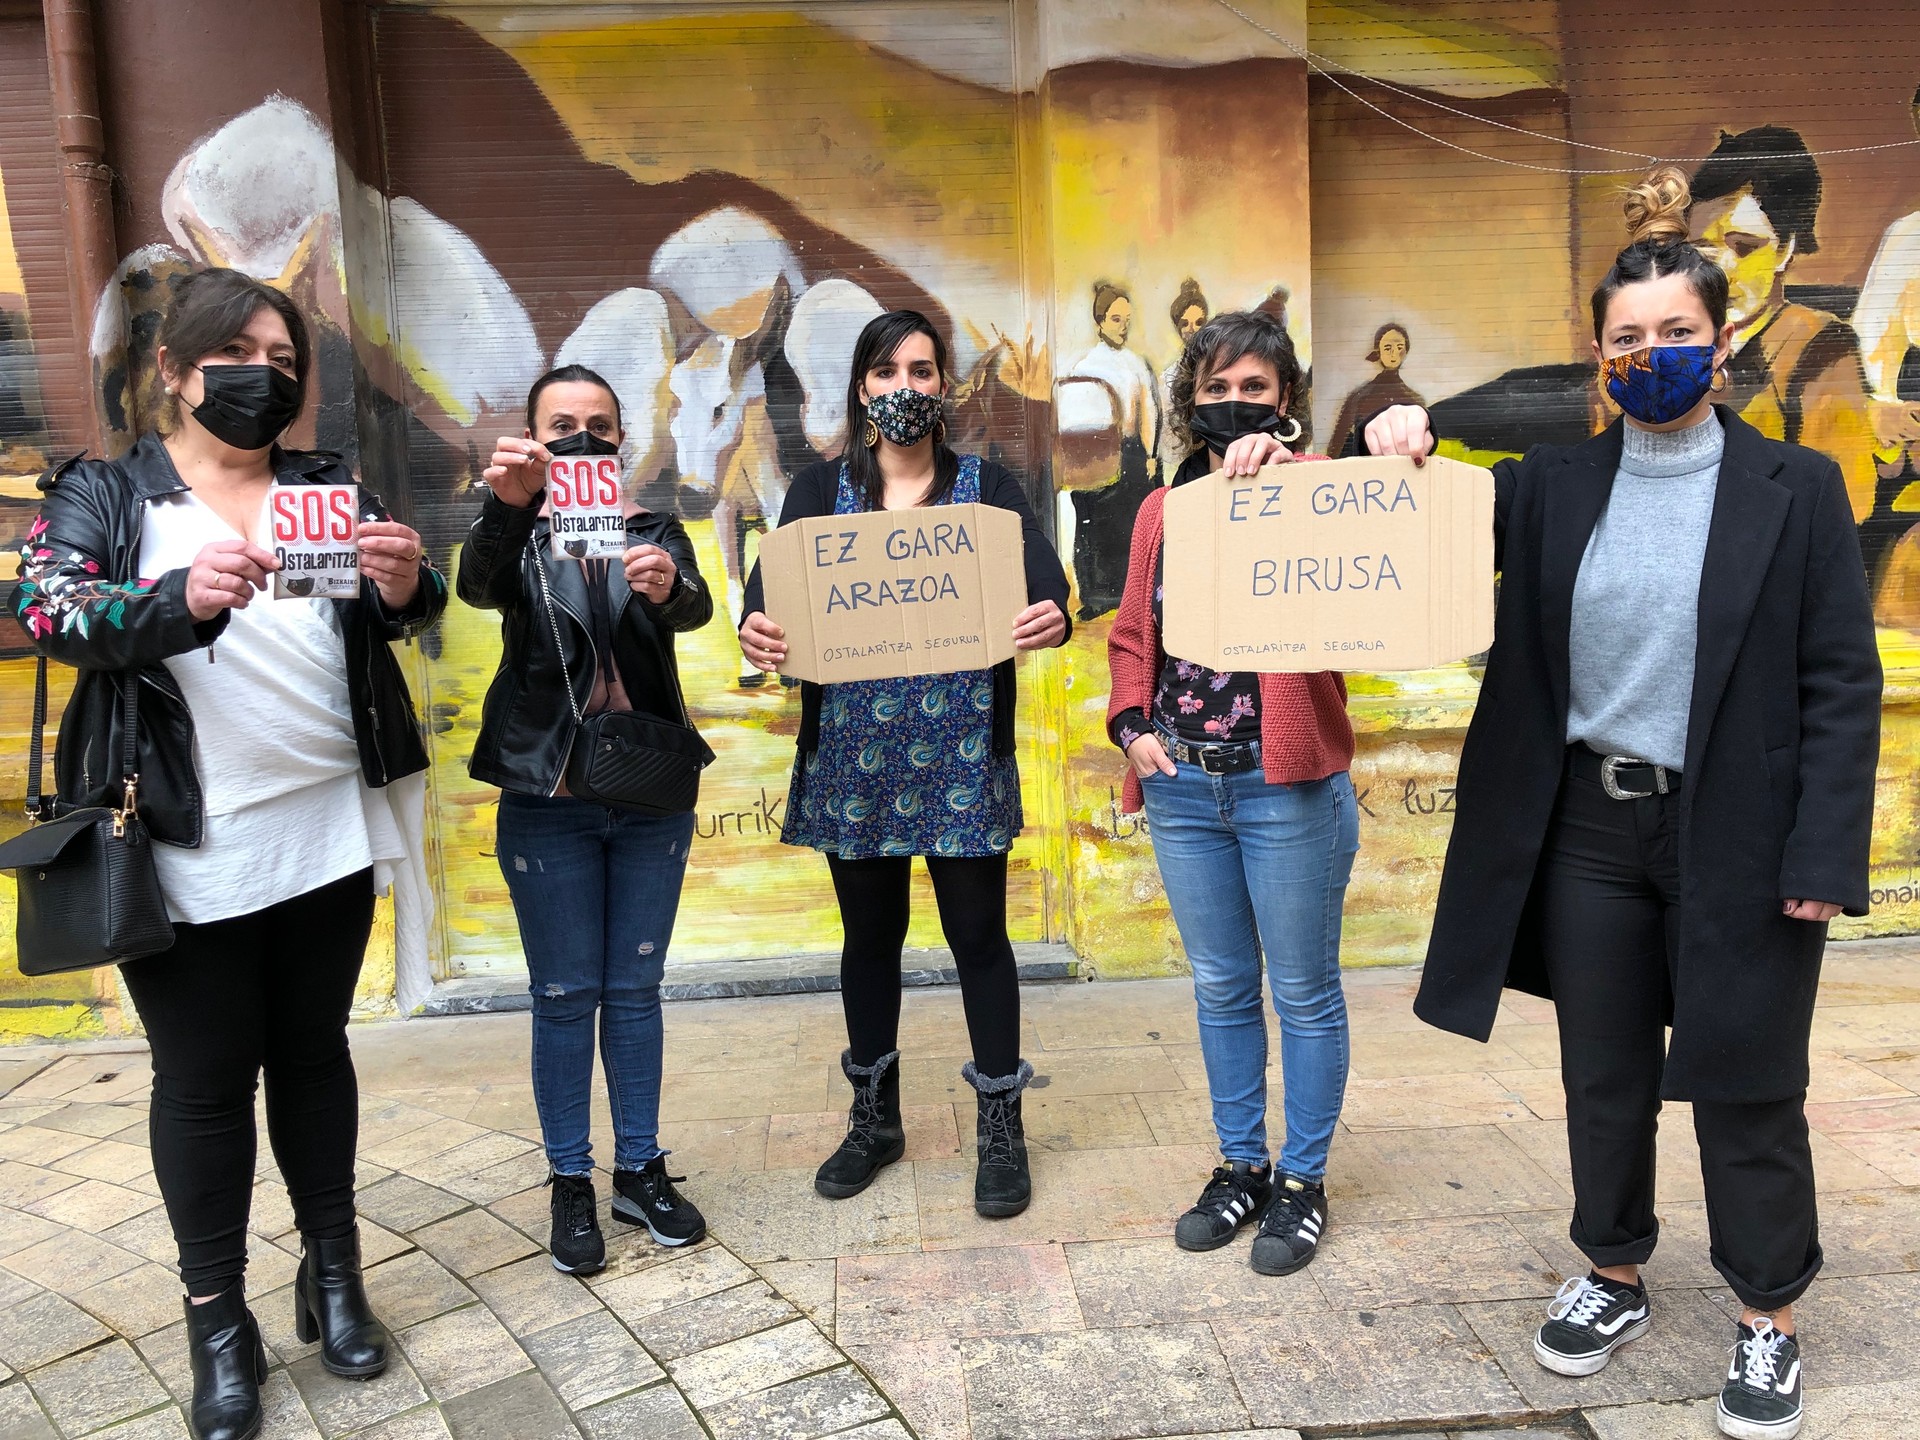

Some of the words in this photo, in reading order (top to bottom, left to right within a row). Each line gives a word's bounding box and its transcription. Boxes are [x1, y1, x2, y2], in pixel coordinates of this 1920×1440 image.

[550, 459, 618, 508] SOS
[1230, 485, 1283, 521] EZ
[1312, 479, 1417, 515] GARA
[274, 490, 352, 541] SOS
[815, 531, 858, 567] EZ
[885, 523, 975, 560] GARA
[826, 572, 960, 614] ARAZOA
[1252, 554, 1402, 596] BIRUSA
[924, 635, 980, 650] SEGURUA
[1323, 640, 1385, 651] SEGURUA
[1869, 880, 1920, 905] onai
